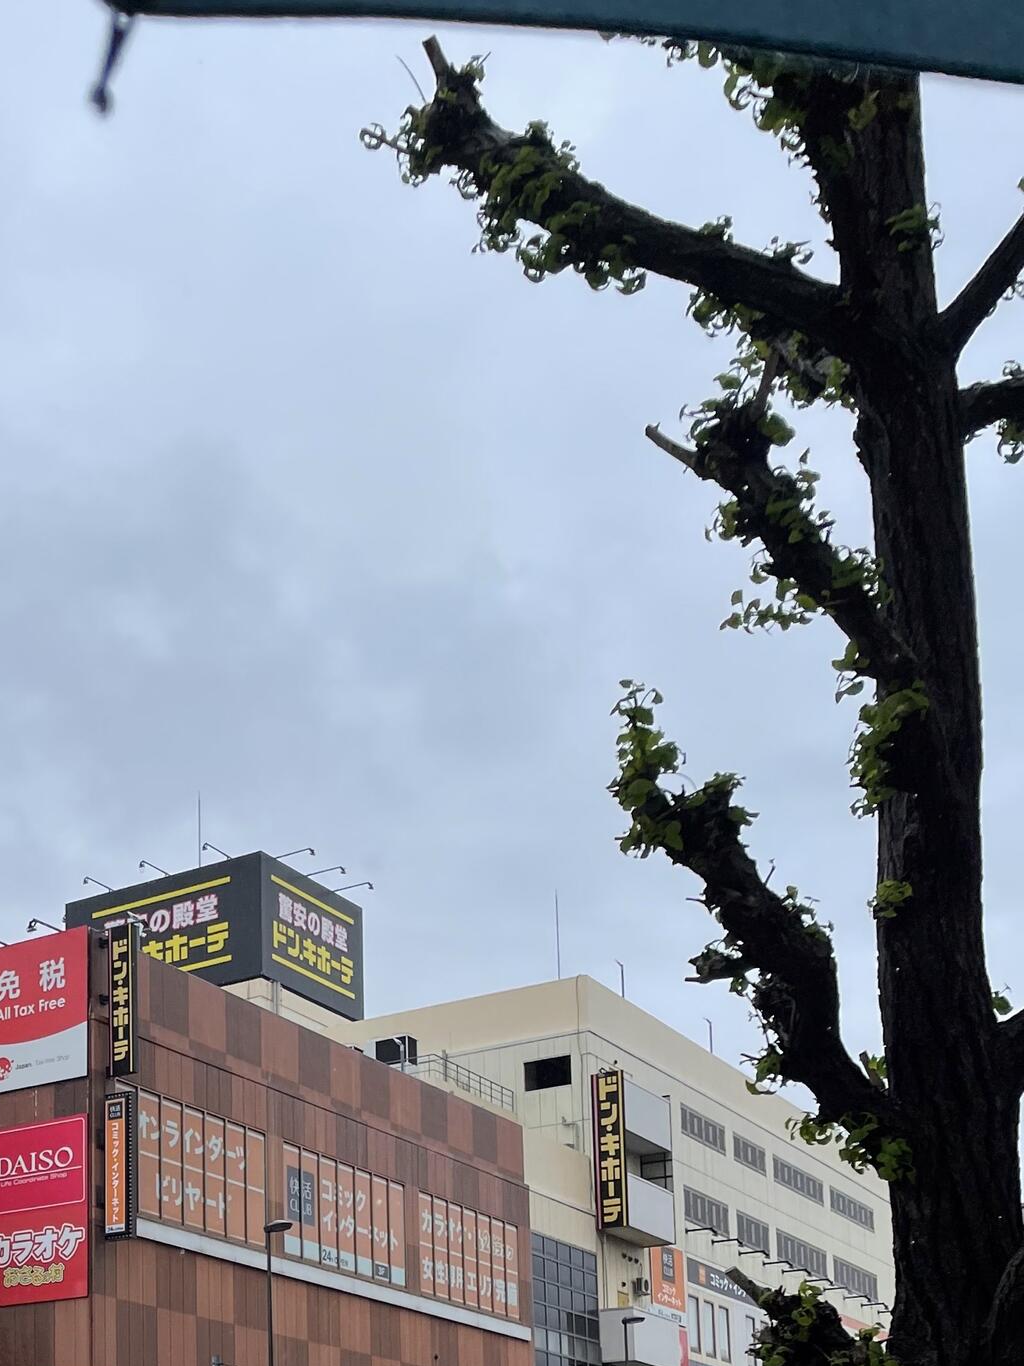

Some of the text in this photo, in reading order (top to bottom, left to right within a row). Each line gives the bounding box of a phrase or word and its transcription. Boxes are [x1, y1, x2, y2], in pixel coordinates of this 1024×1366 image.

[104, 894, 219, 934] の殿堂
[278, 892, 348, 952] 驚安の殿堂
[13, 1003, 35, 1018] Tax
[39, 997, 66, 1013] Free
[112, 939, 129, 1062] ドン・キホーテ
[598, 1076, 622, 1223] ドン・キホーテ
[155, 1173, 233, 1219] ビリヤード
